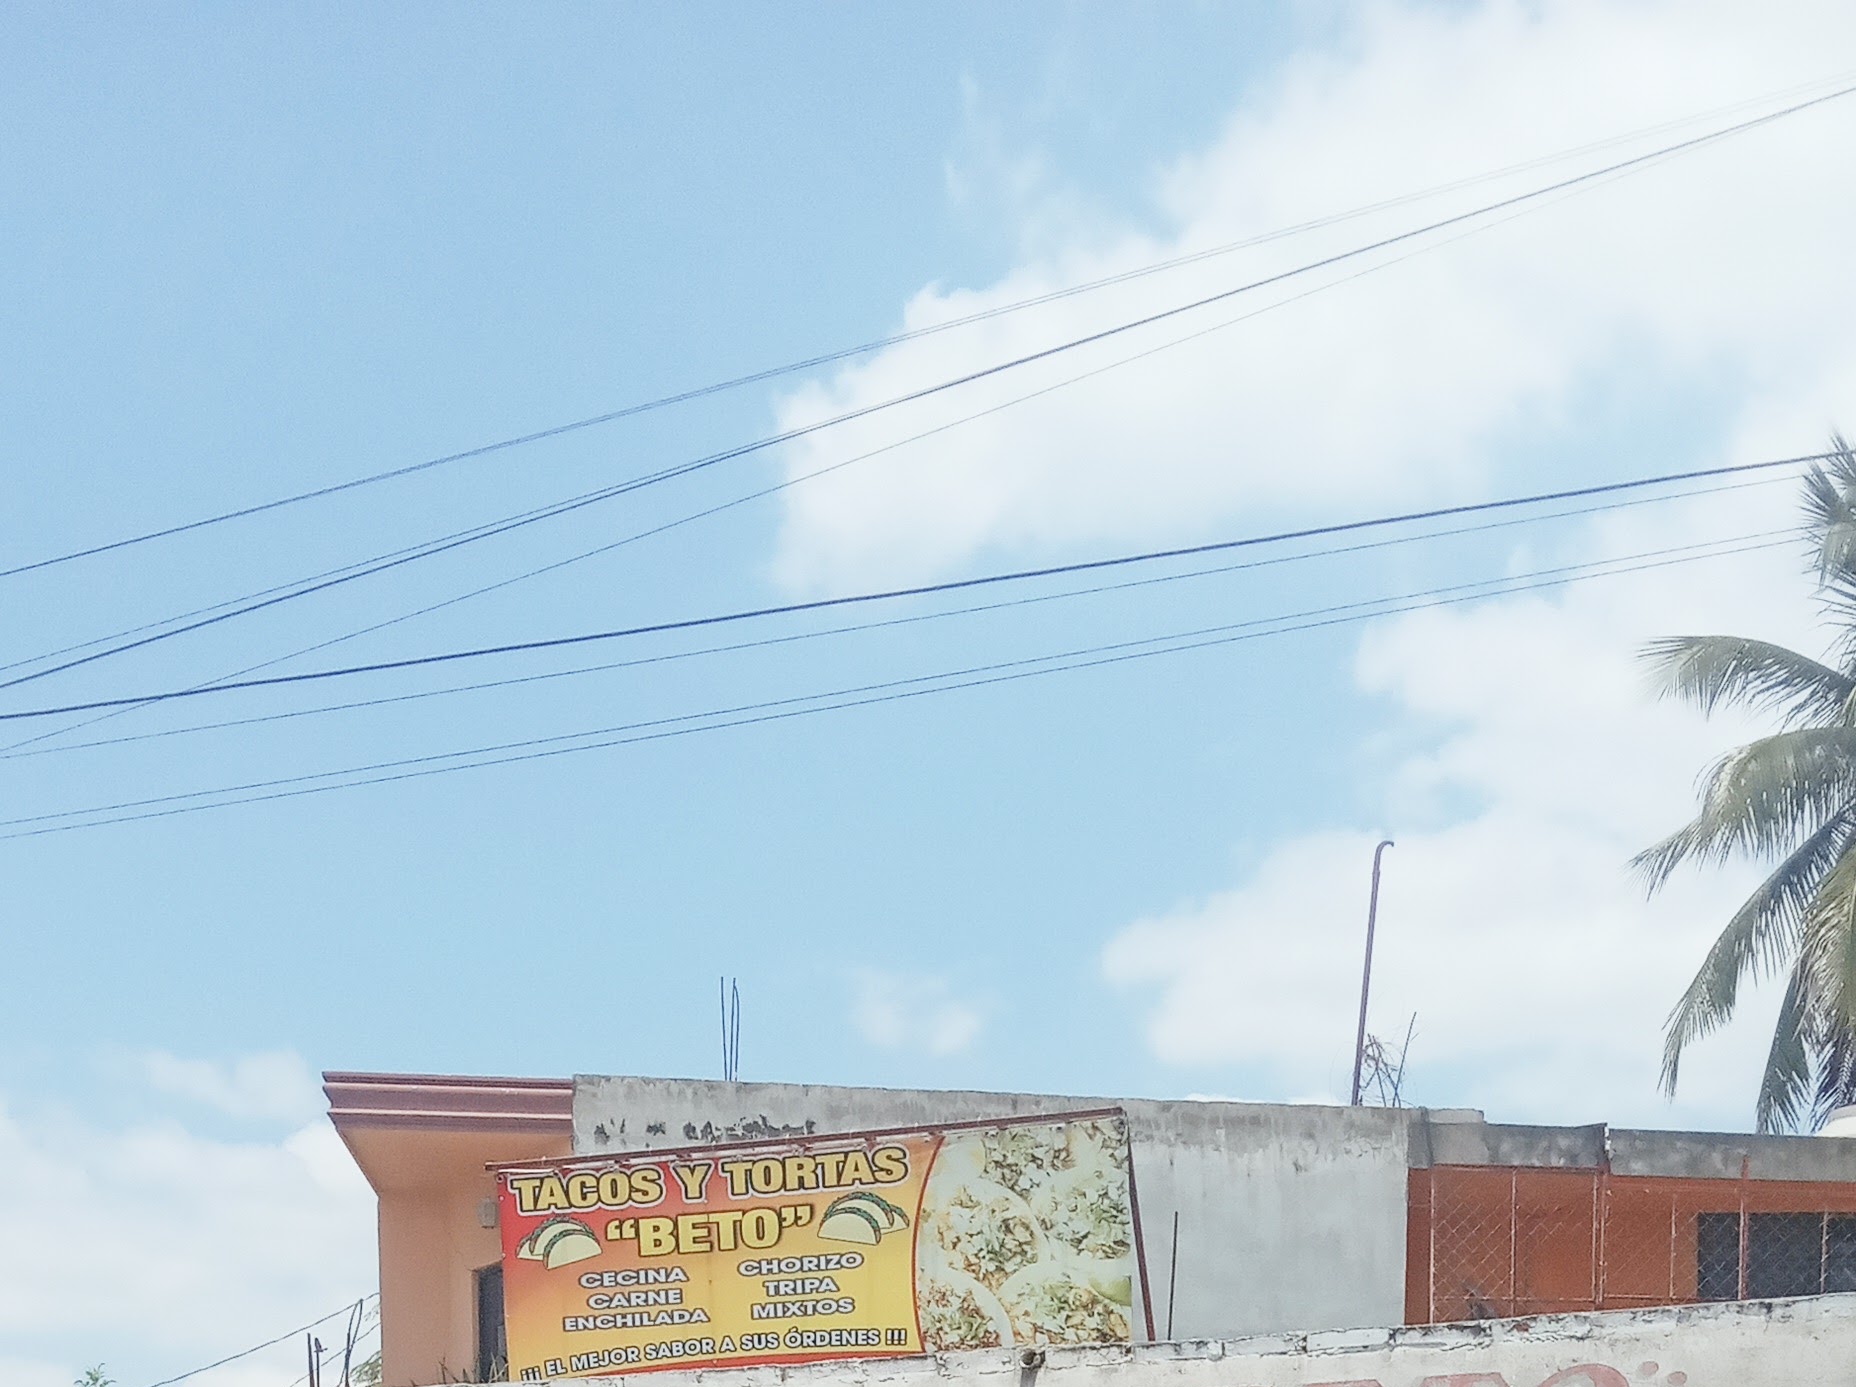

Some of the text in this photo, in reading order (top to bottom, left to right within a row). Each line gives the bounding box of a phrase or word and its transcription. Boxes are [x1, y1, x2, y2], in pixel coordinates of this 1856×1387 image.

[510, 1146, 908, 1213] TACOS Y TORTAS
[605, 1203, 814, 1257] “BETO”
[579, 1265, 690, 1288] CECINA
[737, 1251, 863, 1277] CHORIZO
[586, 1288, 683, 1309] CARNE
[763, 1277, 839, 1297] TRIPA
[562, 1307, 710, 1332] ENCHILADA
[751, 1297, 855, 1321] MIXTOS
[545, 1359, 567, 1377] EL
[570, 1347, 640, 1372] MEJOR
[644, 1337, 716, 1361] SABOR
[720, 1336, 737, 1353] A
[740, 1332, 780, 1350] SUS
[784, 1326, 881, 1348] ÓRDENES
[885, 1328, 907, 1346] !!!
